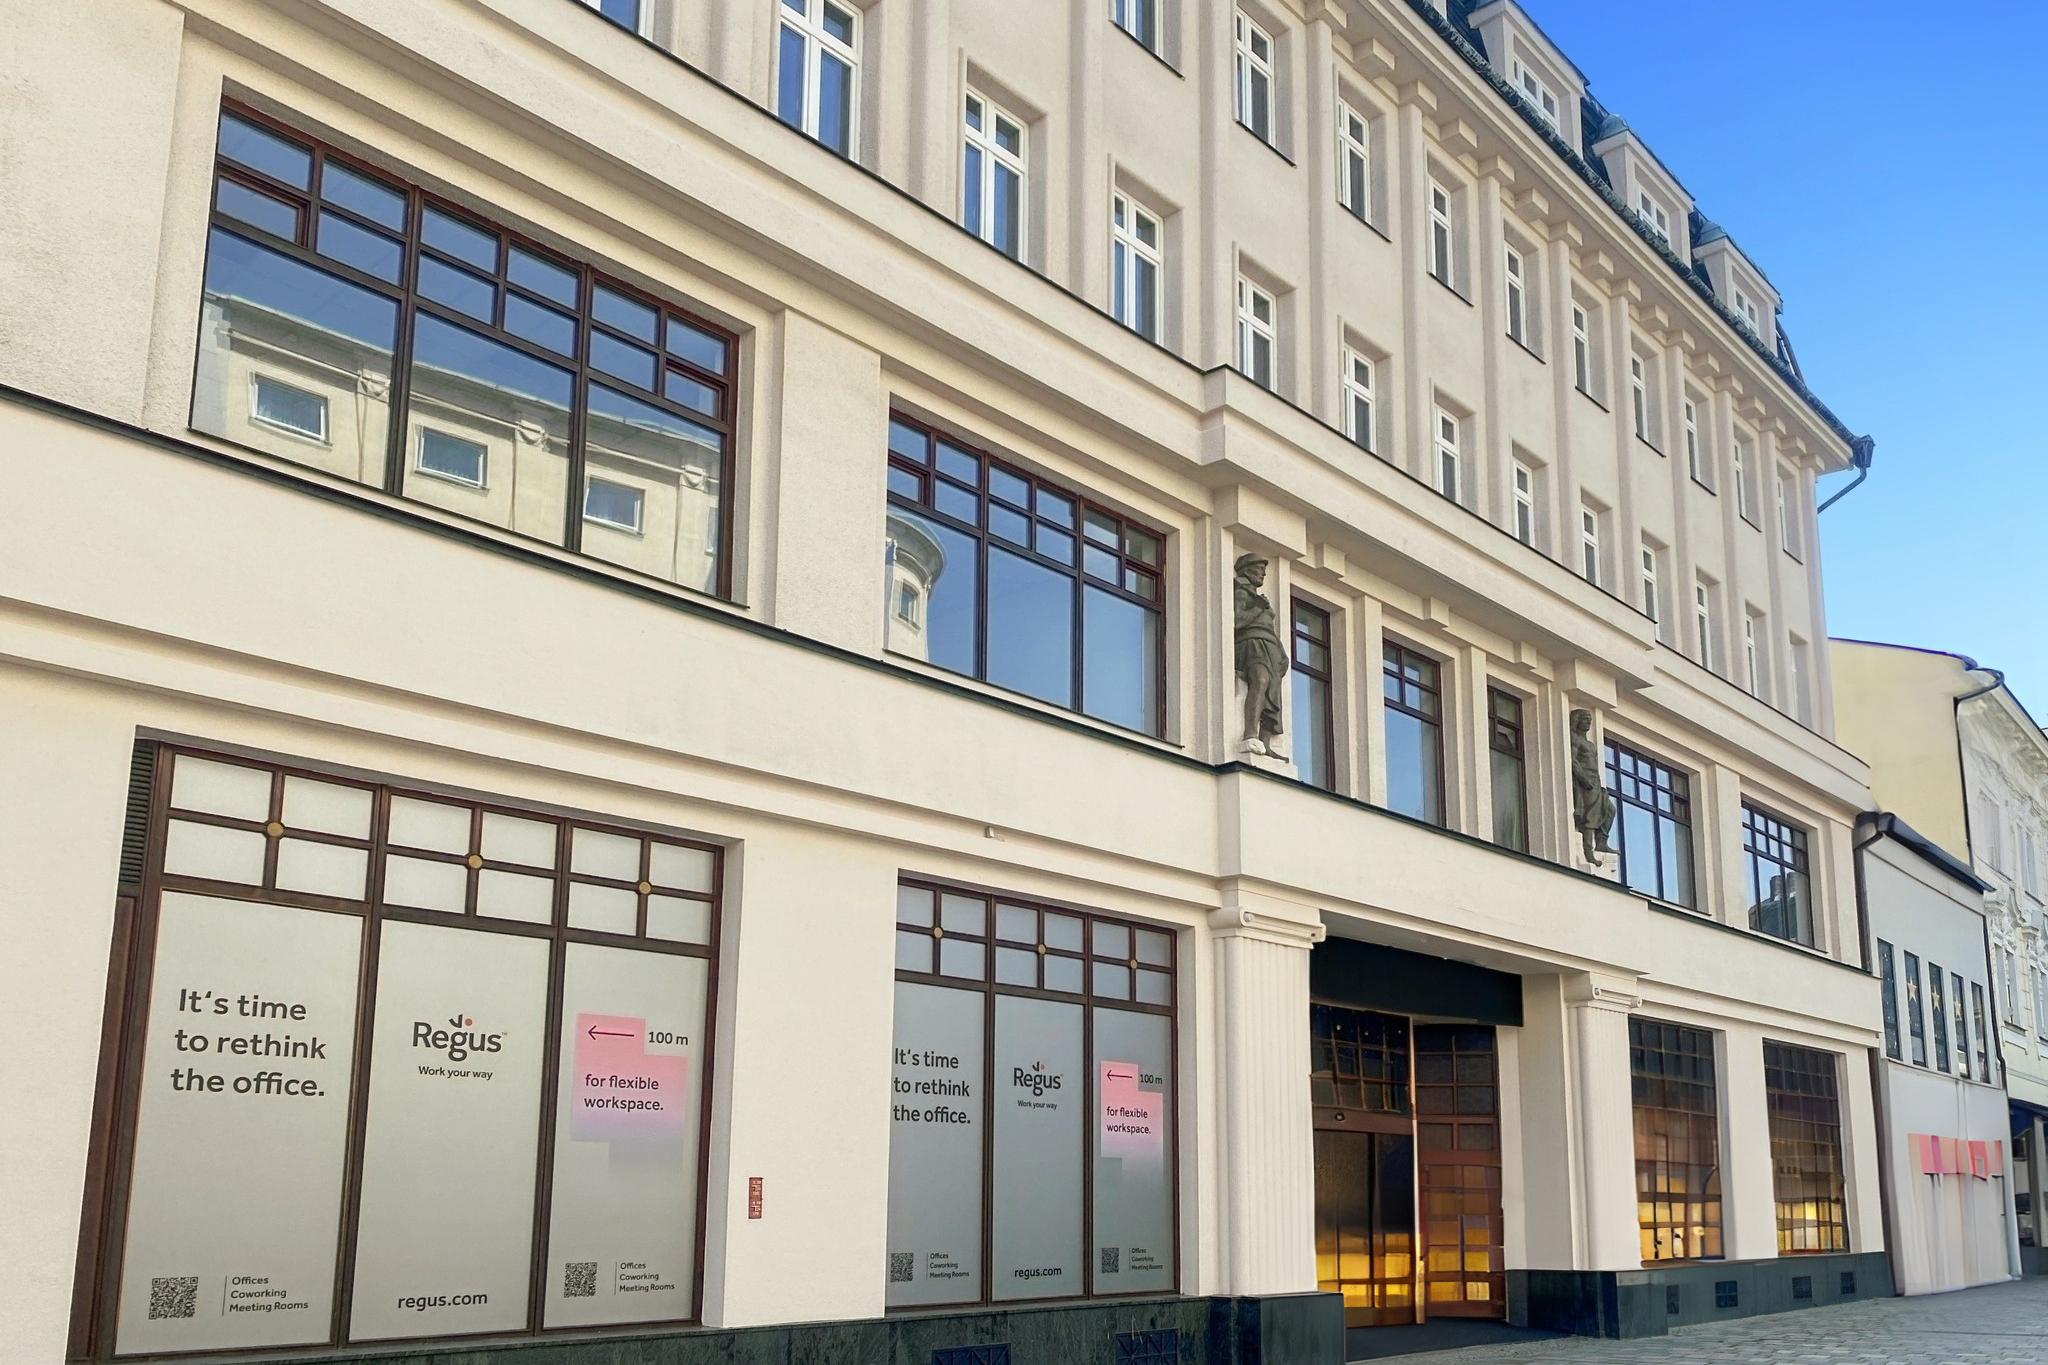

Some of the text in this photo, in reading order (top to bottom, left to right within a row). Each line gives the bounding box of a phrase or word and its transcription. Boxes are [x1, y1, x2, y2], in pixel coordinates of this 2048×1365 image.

[237, 994, 307, 1021] time
[174, 1029, 327, 1060] to rethink
[412, 1020, 502, 1062] Regus
[648, 1031, 689, 1046] 100 m
[923, 1050, 959, 1069] time
[418, 1065, 493, 1081] Work your way
[1139, 1073, 1154, 1084] 100
[170, 1067, 325, 1097] the office.
[585, 1073, 659, 1090] for flexible
[893, 1076, 970, 1097] to rethink
[1013, 1067, 1061, 1097] Regus
[583, 1096, 664, 1113] workspace.
[1106, 1105, 1148, 1119] for flexible
[893, 1104, 971, 1124] the office.
[1106, 1123, 1152, 1135] workspace.
[620, 1262, 647, 1270] Offices
[1014, 1266, 1062, 1280] regus.com
[231, 1276, 270, 1286] Offices
[619, 1272, 659, 1281] Coworking
[230, 1288, 287, 1299] Coworking
[619, 1283, 675, 1293] Meeting Rooms
[229, 1301, 309, 1313] Meeting Rooms
[397, 1293, 488, 1312] regus.com
